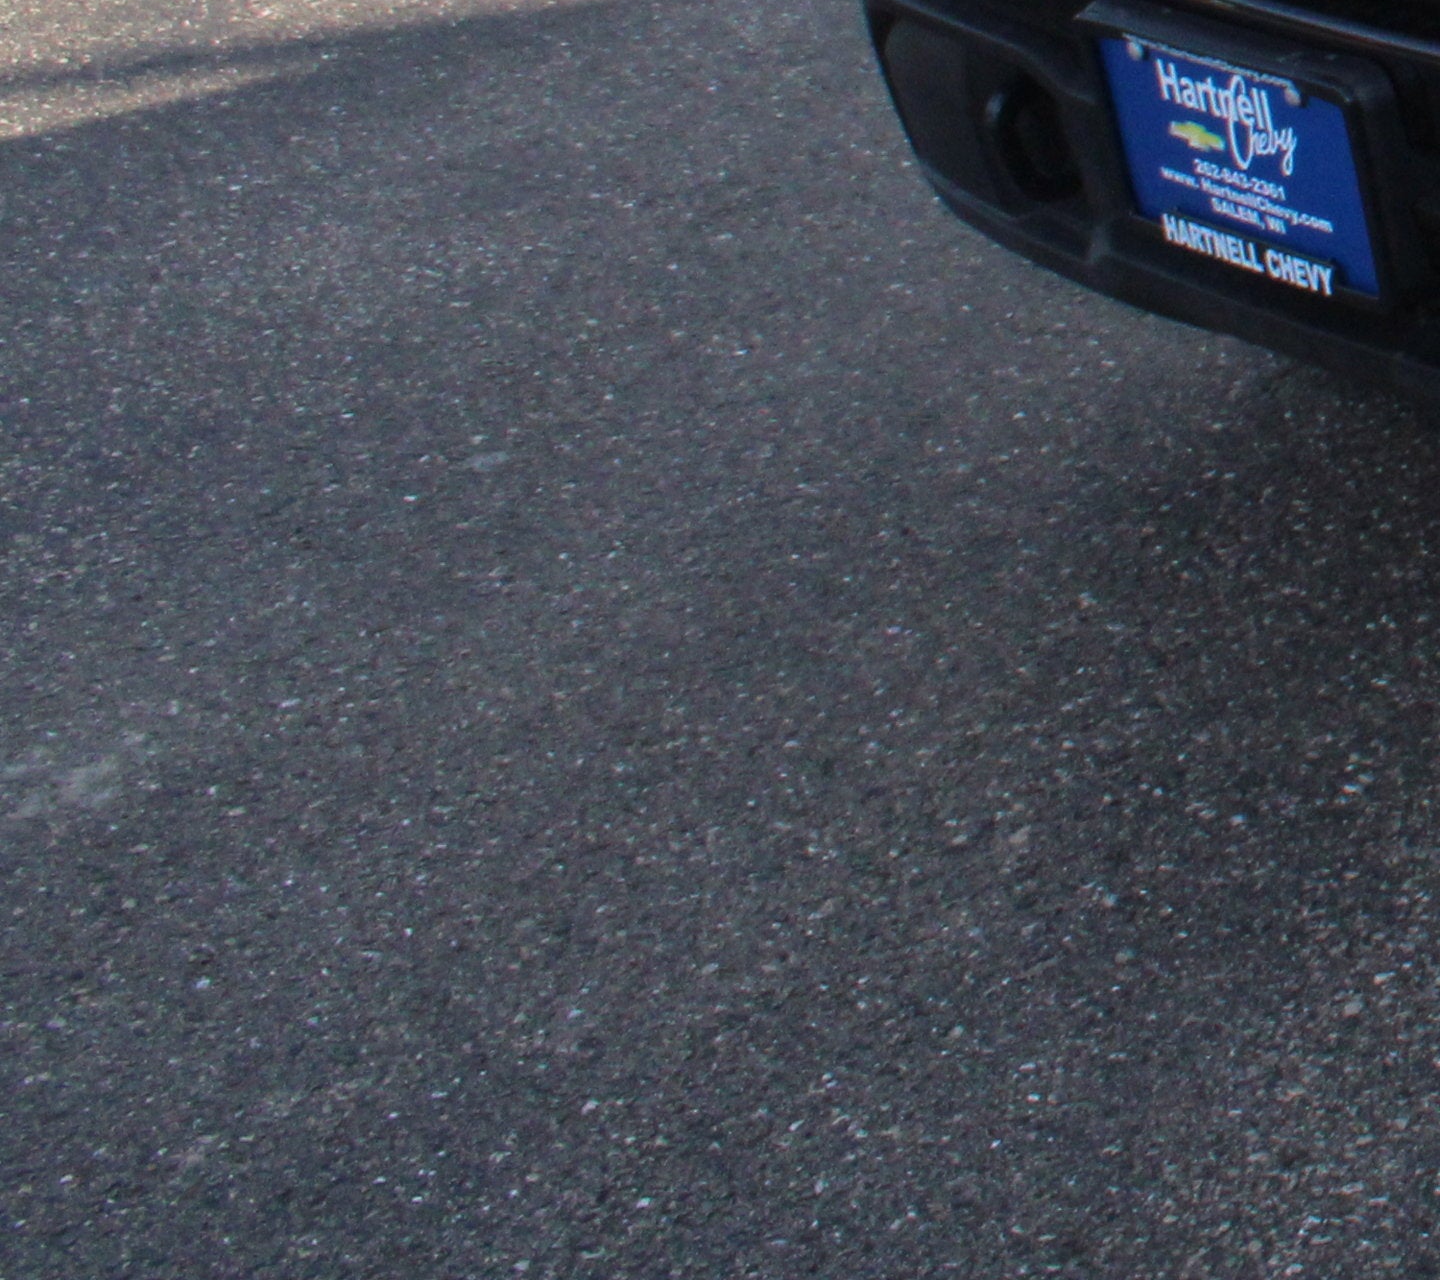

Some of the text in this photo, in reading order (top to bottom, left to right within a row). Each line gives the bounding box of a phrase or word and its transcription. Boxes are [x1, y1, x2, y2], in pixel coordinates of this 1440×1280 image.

[1155, 57, 1273, 130] Hartnell
[1227, 74, 1298, 177] Chevy
[1161, 212, 1333, 297] HARTNELL CHEVY
